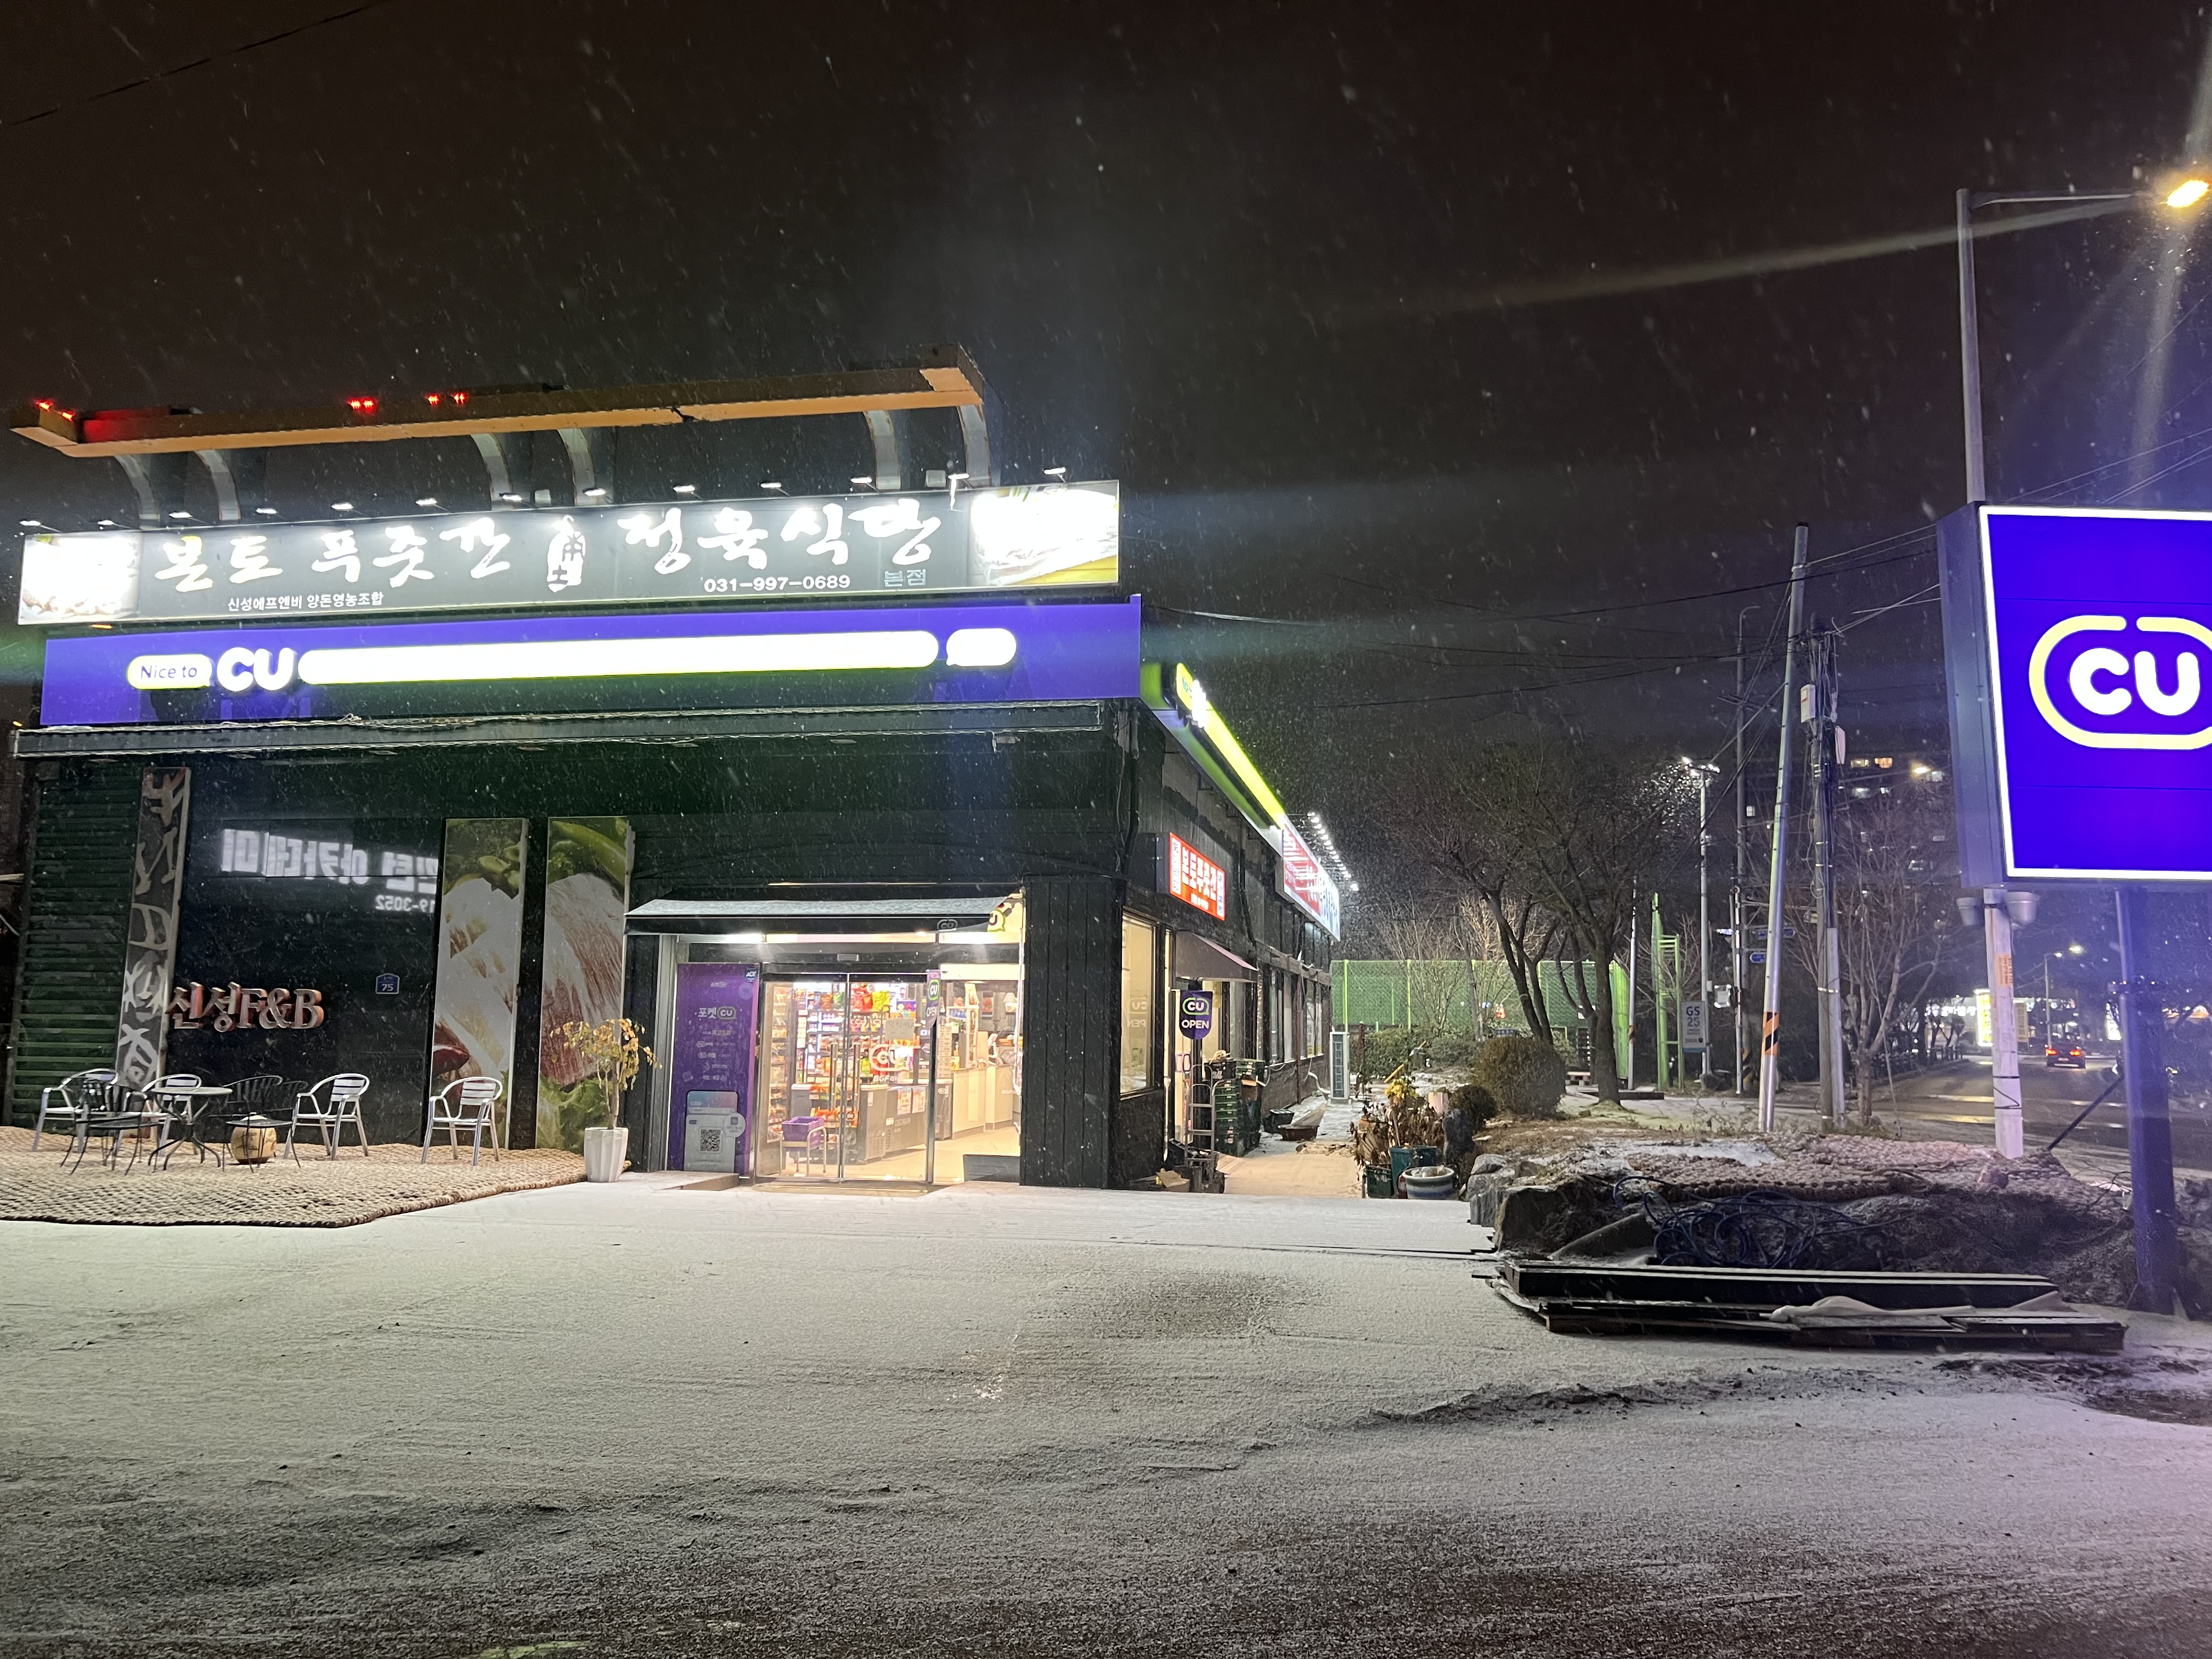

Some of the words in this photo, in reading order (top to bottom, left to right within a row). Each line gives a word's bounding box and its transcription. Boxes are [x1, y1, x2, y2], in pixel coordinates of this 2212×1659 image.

[617, 498, 941, 574] 정육식당
[704, 574, 851, 592] 031-997-0689
[884, 569, 926, 587] 본점
[228, 594, 302, 611] 신성에프엔비
[307, 591, 383, 608] 양돈영농조합
[140, 665, 176, 679] Nice
[182, 665, 198, 678] to
[217, 647, 296, 692] CU
[2069, 648, 2200, 716] CU
[930, 984, 938, 996] CU
[698, 1007, 716, 1019] 포켓
[1187, 1001, 1205, 1011] CU
[1686, 1006, 1700, 1016] GS
[1181, 1020, 1209, 1029] OPEN
[1687, 1017, 1700, 1028] 25
